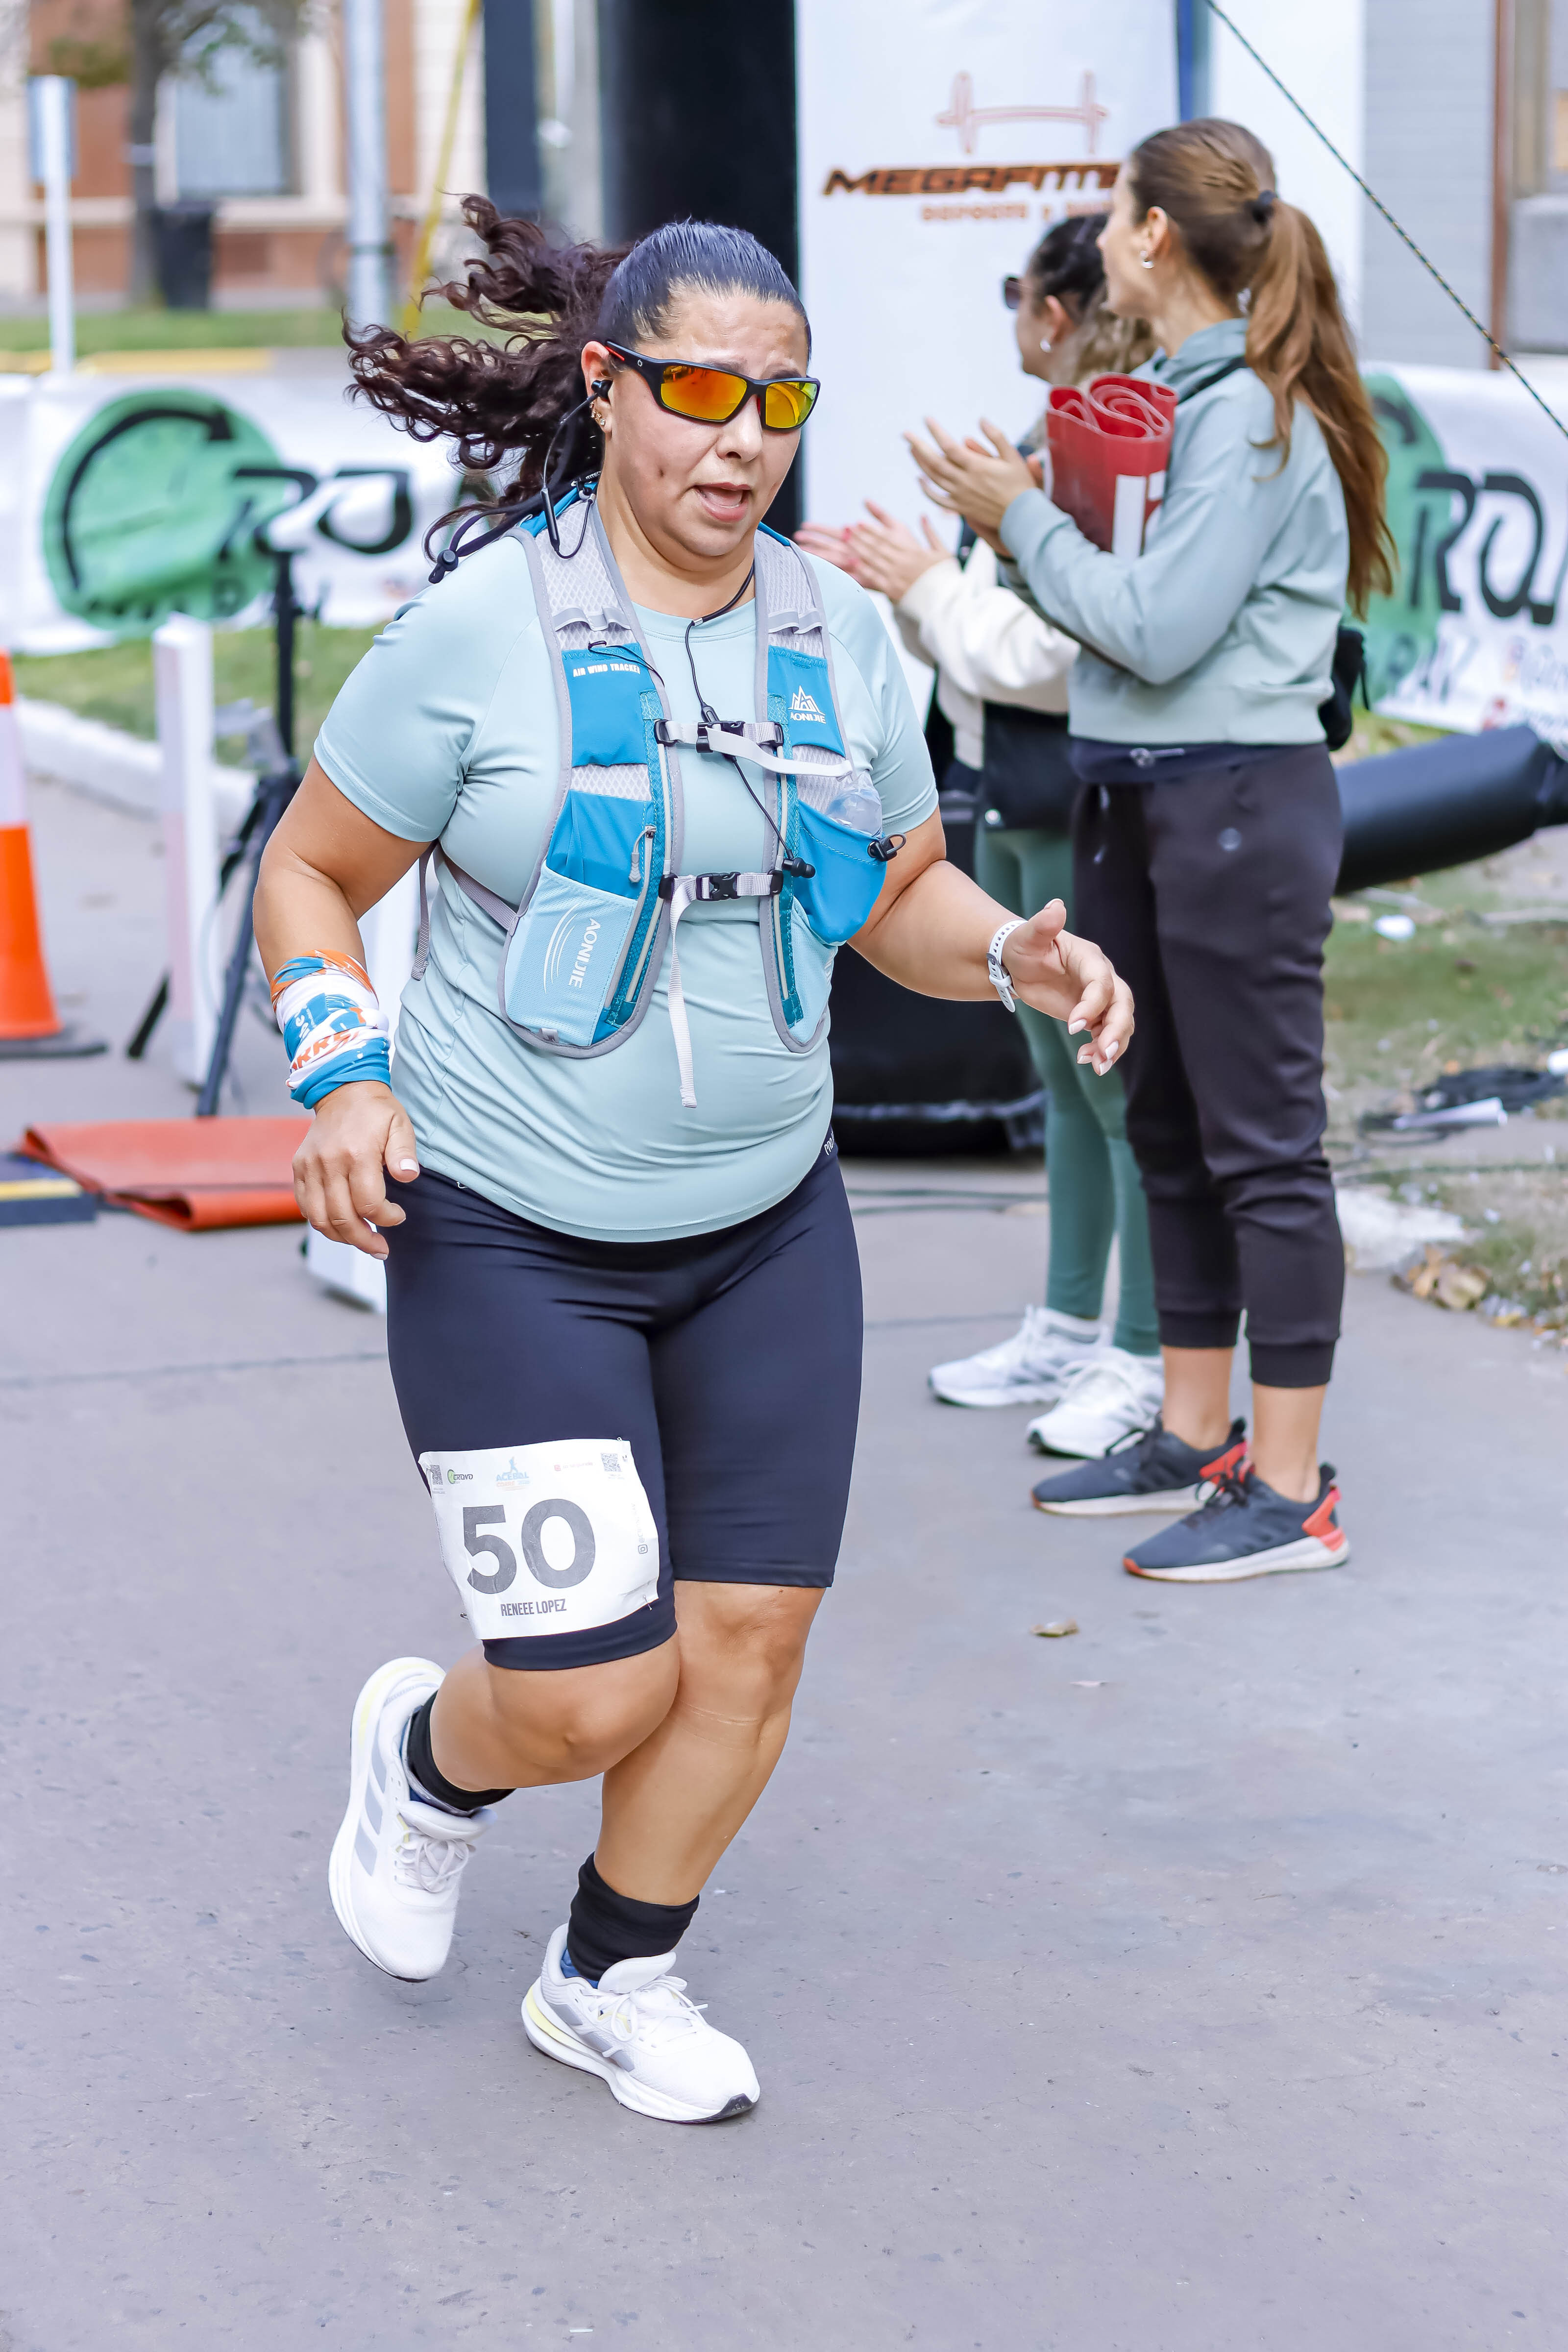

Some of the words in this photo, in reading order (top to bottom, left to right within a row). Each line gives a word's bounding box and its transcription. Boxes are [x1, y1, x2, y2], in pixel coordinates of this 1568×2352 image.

[573, 667, 586, 677] AIR
[587, 664, 608, 674] WIND
[790, 711, 827, 724] AONIJIE
[568, 918, 601, 988] AONIJIE
[463, 1498, 595, 1594] 50
[500, 1602, 535, 1617] RENEEE
[536, 1598, 567, 1614] LOPEZ
